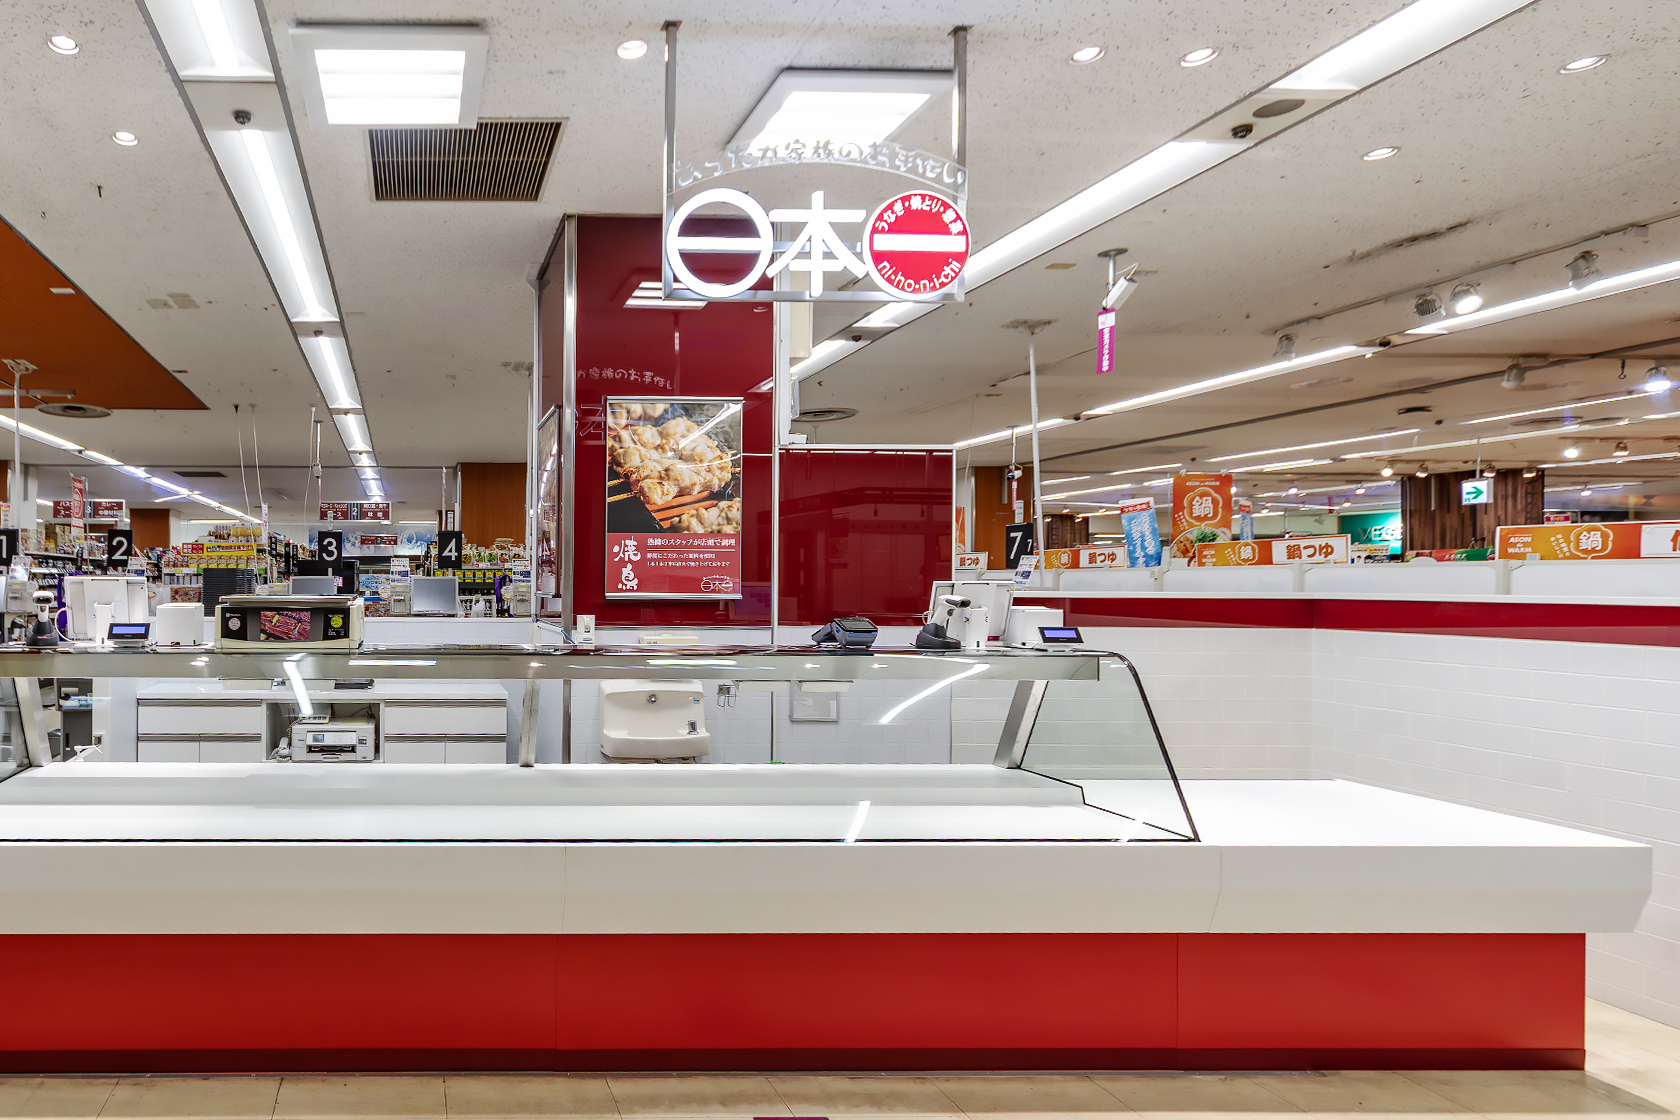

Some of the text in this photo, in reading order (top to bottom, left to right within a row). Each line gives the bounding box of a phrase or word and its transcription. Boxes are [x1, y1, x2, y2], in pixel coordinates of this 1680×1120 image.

[352, 507, 358, 516] 2
[1191, 496, 1214, 518] 鍋
[111, 536, 128, 560] 2
[322, 537, 338, 561] 3
[442, 538, 458, 561] 4
[1010, 531, 1023, 560] 7
[1286, 542, 1334, 560] 鍋つゆ
[1579, 531, 1602, 551] 鍋
[1088, 547, 1117, 565] 鍋つゆ
